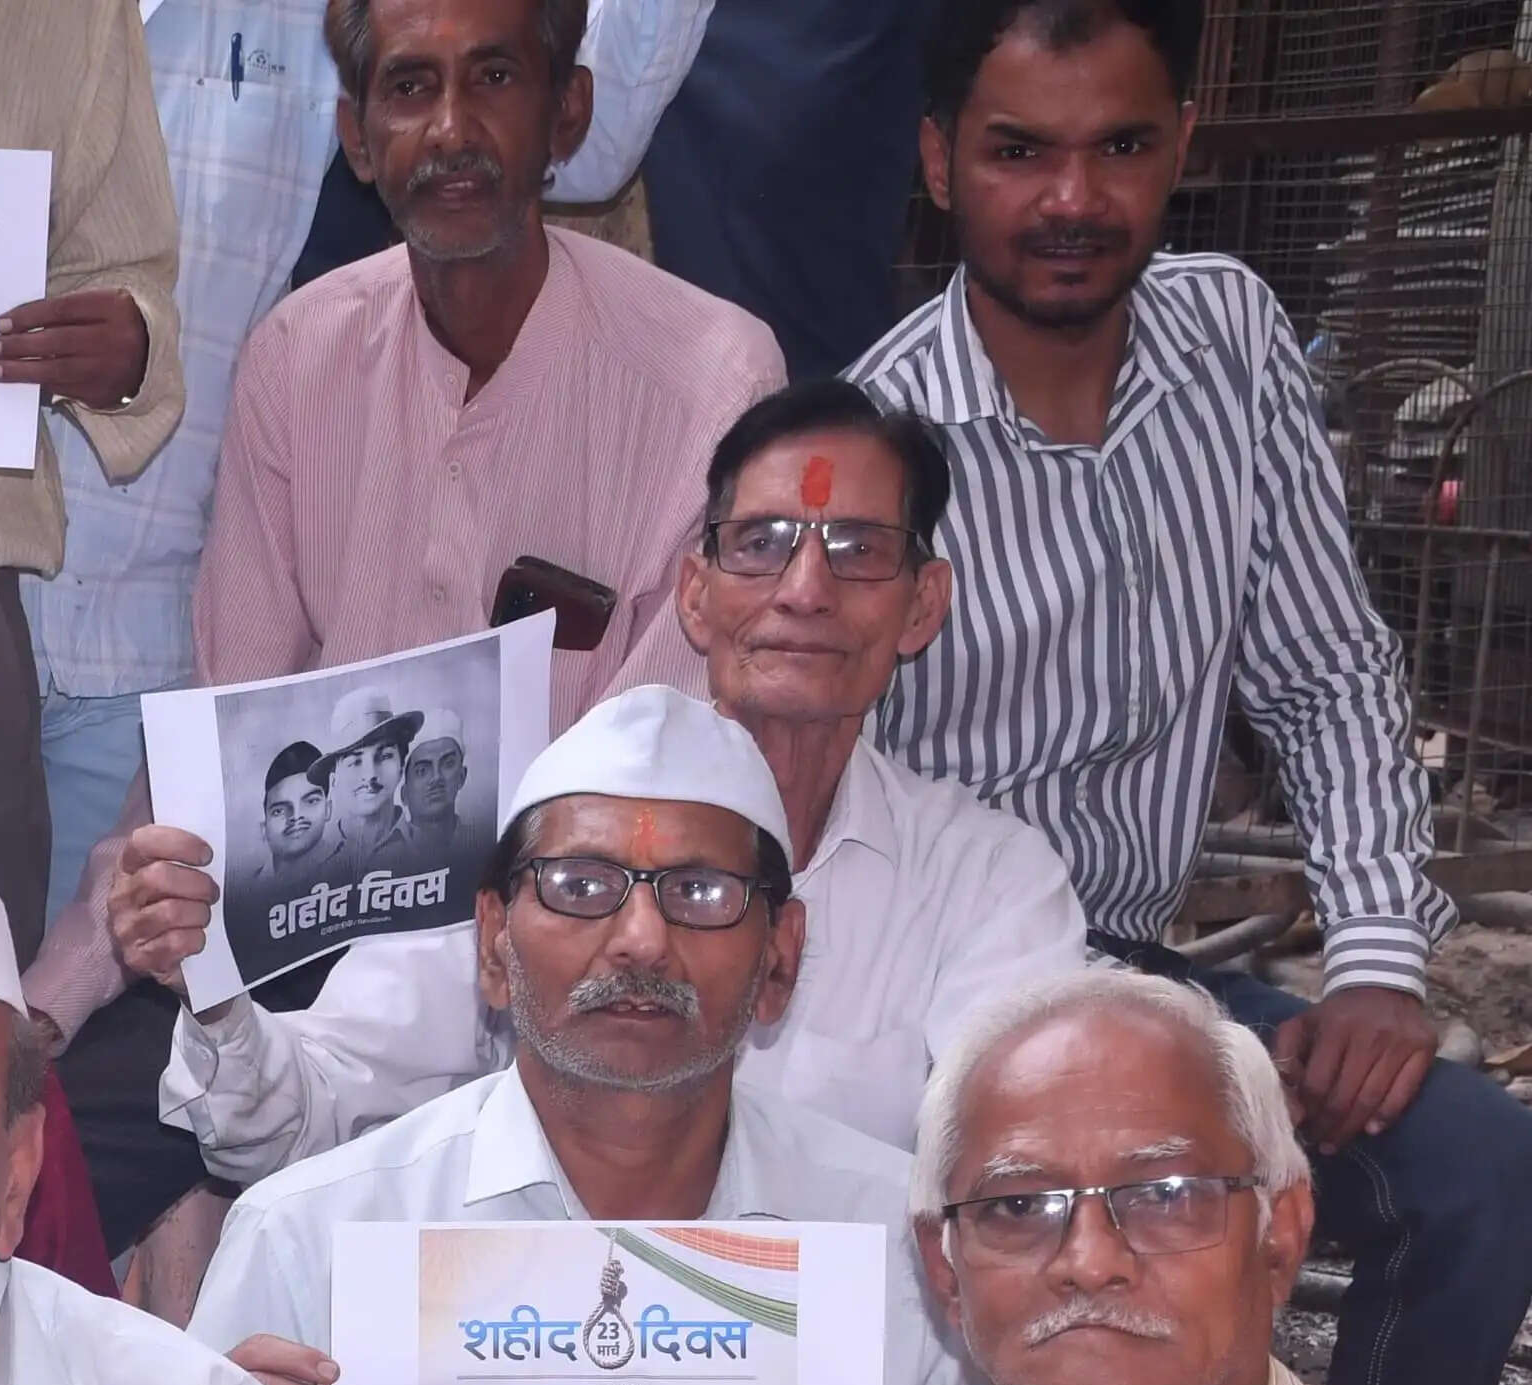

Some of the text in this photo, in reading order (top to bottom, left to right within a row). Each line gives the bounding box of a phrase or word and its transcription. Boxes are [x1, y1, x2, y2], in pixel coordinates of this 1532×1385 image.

[269, 867, 450, 940] शहीद दिवस
[458, 1304, 753, 1362] शहीद दिवस
[597, 1322, 619, 1340] 23
[597, 1339, 620, 1357] मार्च
